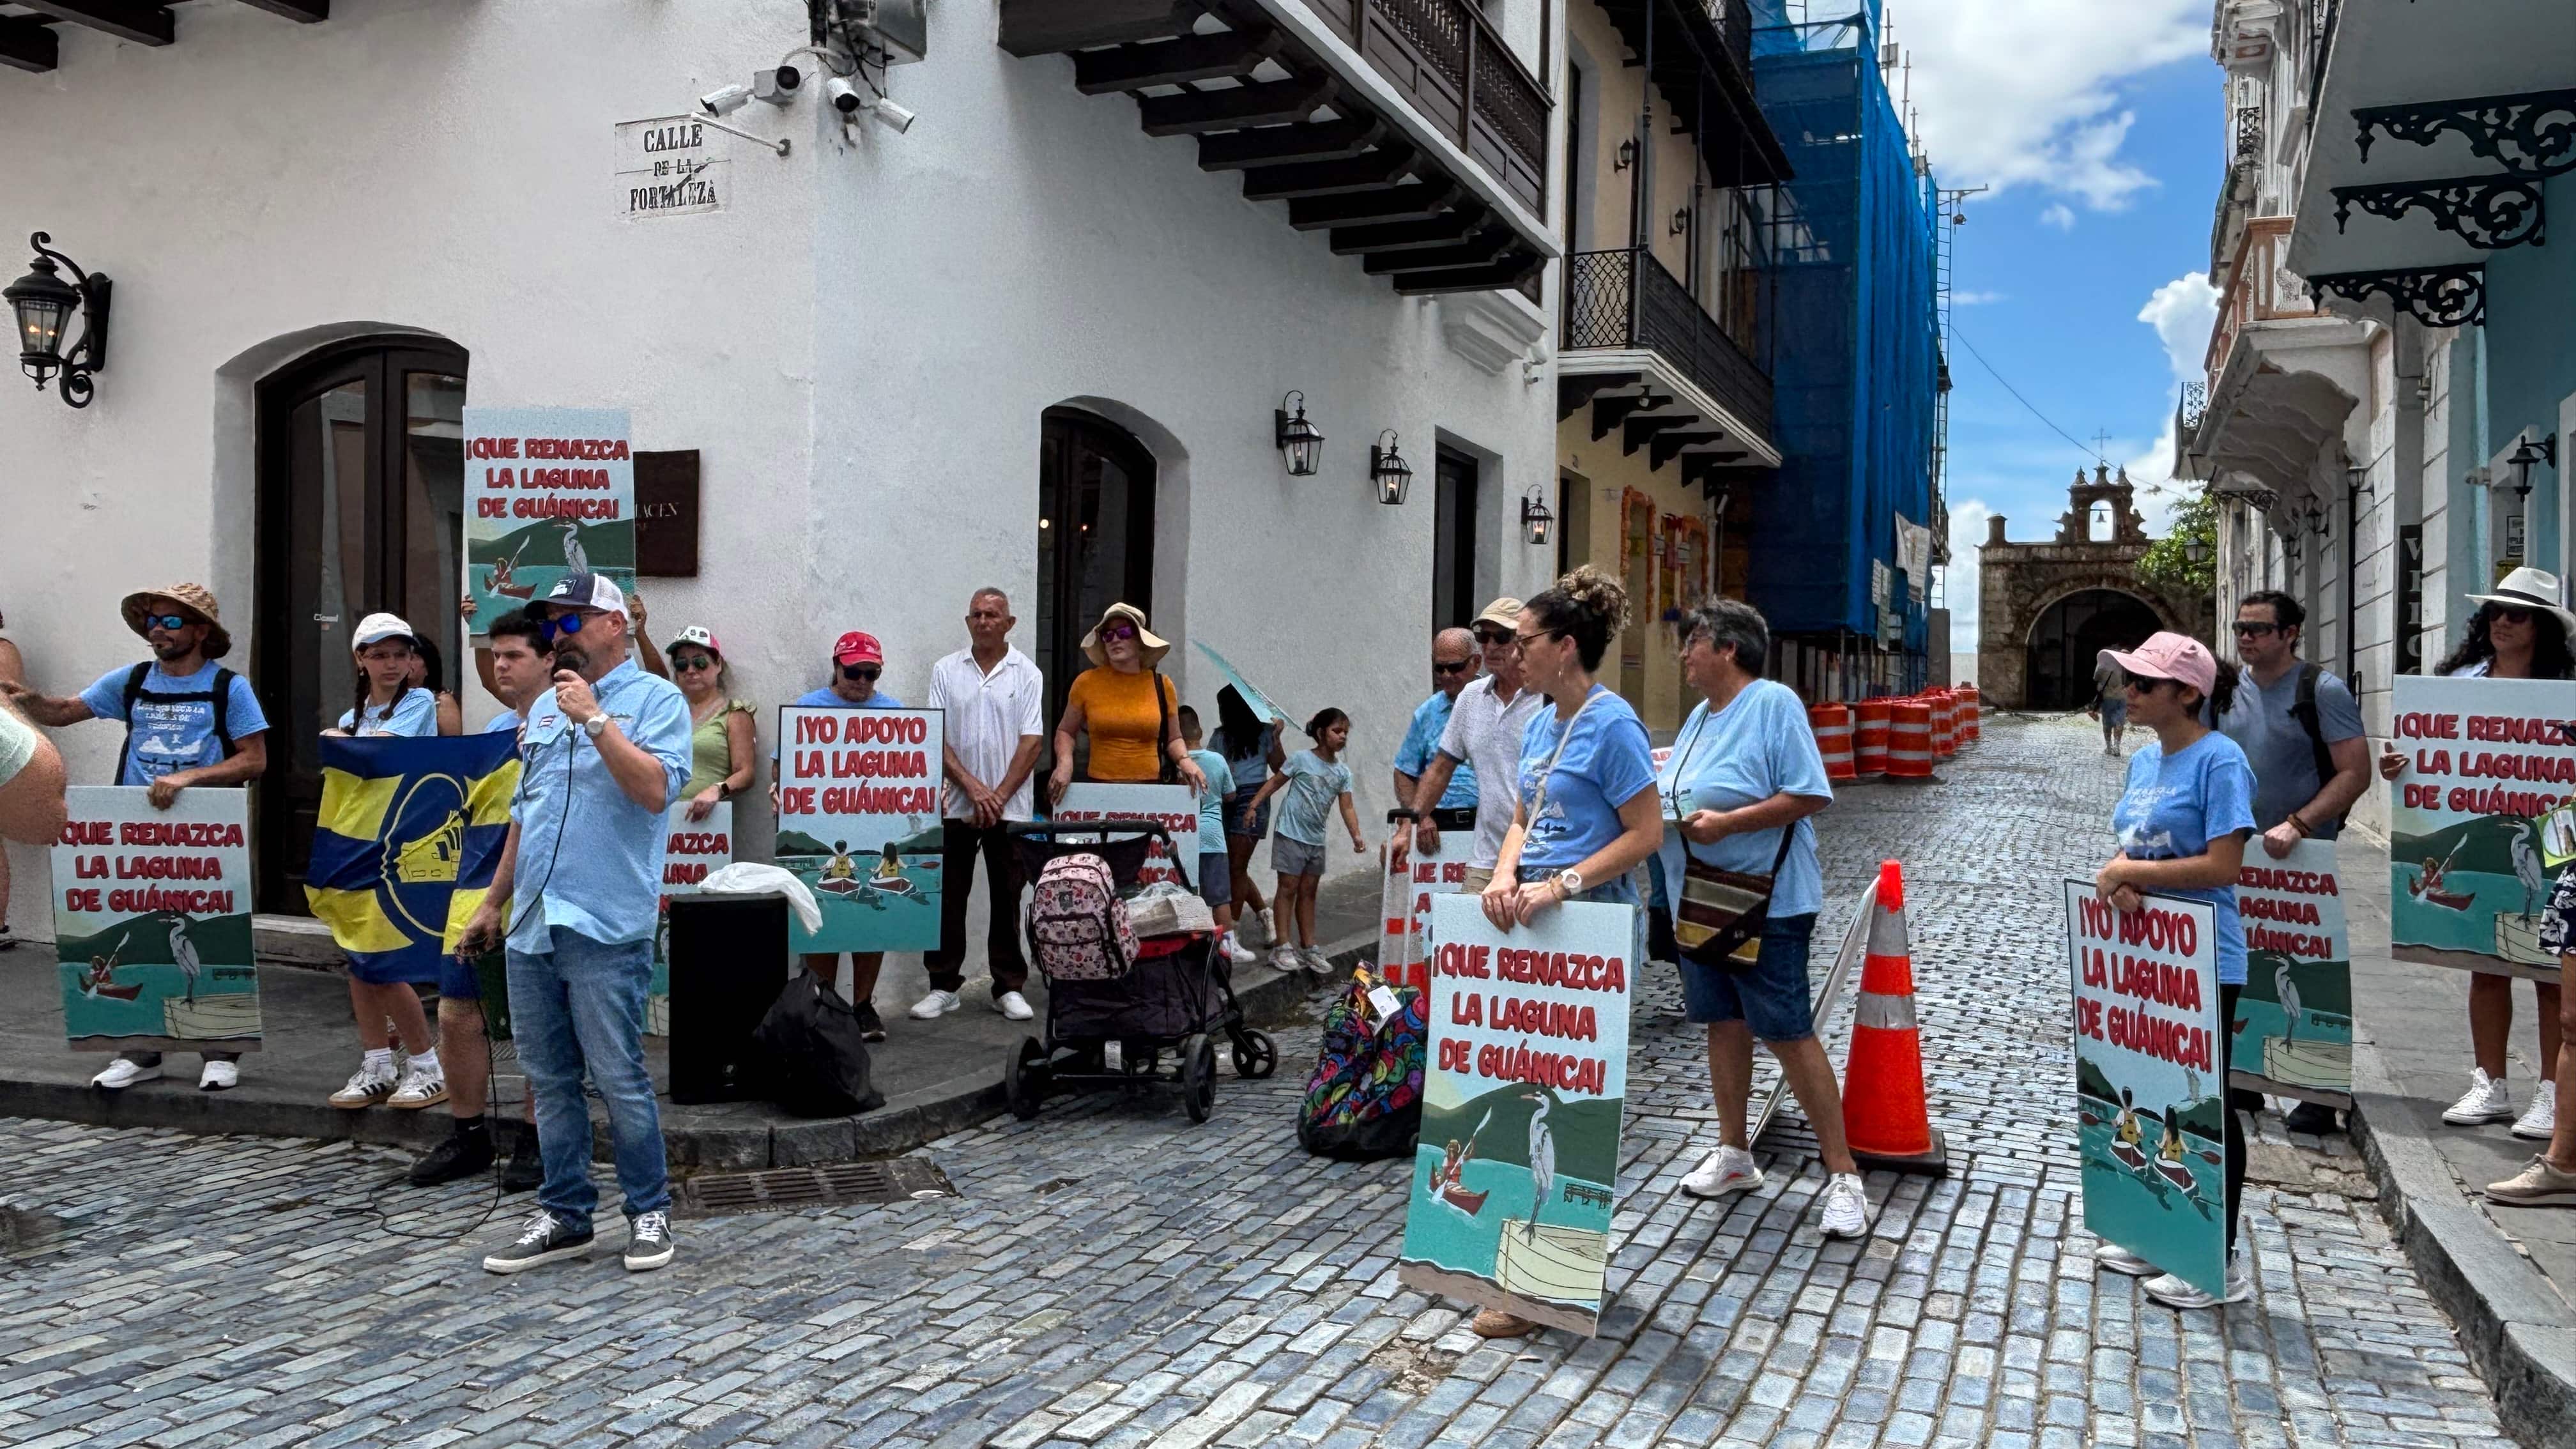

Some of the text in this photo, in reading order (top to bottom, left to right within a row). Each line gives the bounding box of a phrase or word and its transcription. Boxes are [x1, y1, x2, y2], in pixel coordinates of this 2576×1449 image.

[644, 124, 702, 152] CALLE
[654, 158, 692, 176] DE LA
[630, 180, 716, 211] FORTALEZA
[466, 437, 630, 461] ¡QUE RENAZCA
[486, 468, 611, 490] LA LAGUNA
[478, 492, 619, 519] DE GUÁNICA!
[796, 716, 926, 744] ¡YO APOYO
[2393, 712, 2459, 740] ¡QUE
[795, 750, 928, 778] LA LAGUNA
[2416, 749, 2576, 784] LA LAGUNA
[783, 779, 936, 815] DE GUÁNICA!
[2404, 783, 2441, 810] DE
[119, 822, 245, 847] RENAZCA
[667, 832, 729, 854] AZCA
[75, 855, 223, 880] LA LAGUNA
[66, 883, 234, 914] DE GUÁNICA!
[2239, 896, 2320, 926] AGUNA
[2078, 895, 2196, 957] ¡YO APOYO
[1432, 942, 1625, 993] ¡QUE RENAZCA
[2082, 946, 2202, 1013] LA LAGUNA
[1452, 992, 1597, 1043] LA LAGUNA
[2077, 996, 2212, 1073] DE GUÁNICA!
[1439, 1038, 1606, 1096] DE GUÁNICA!
